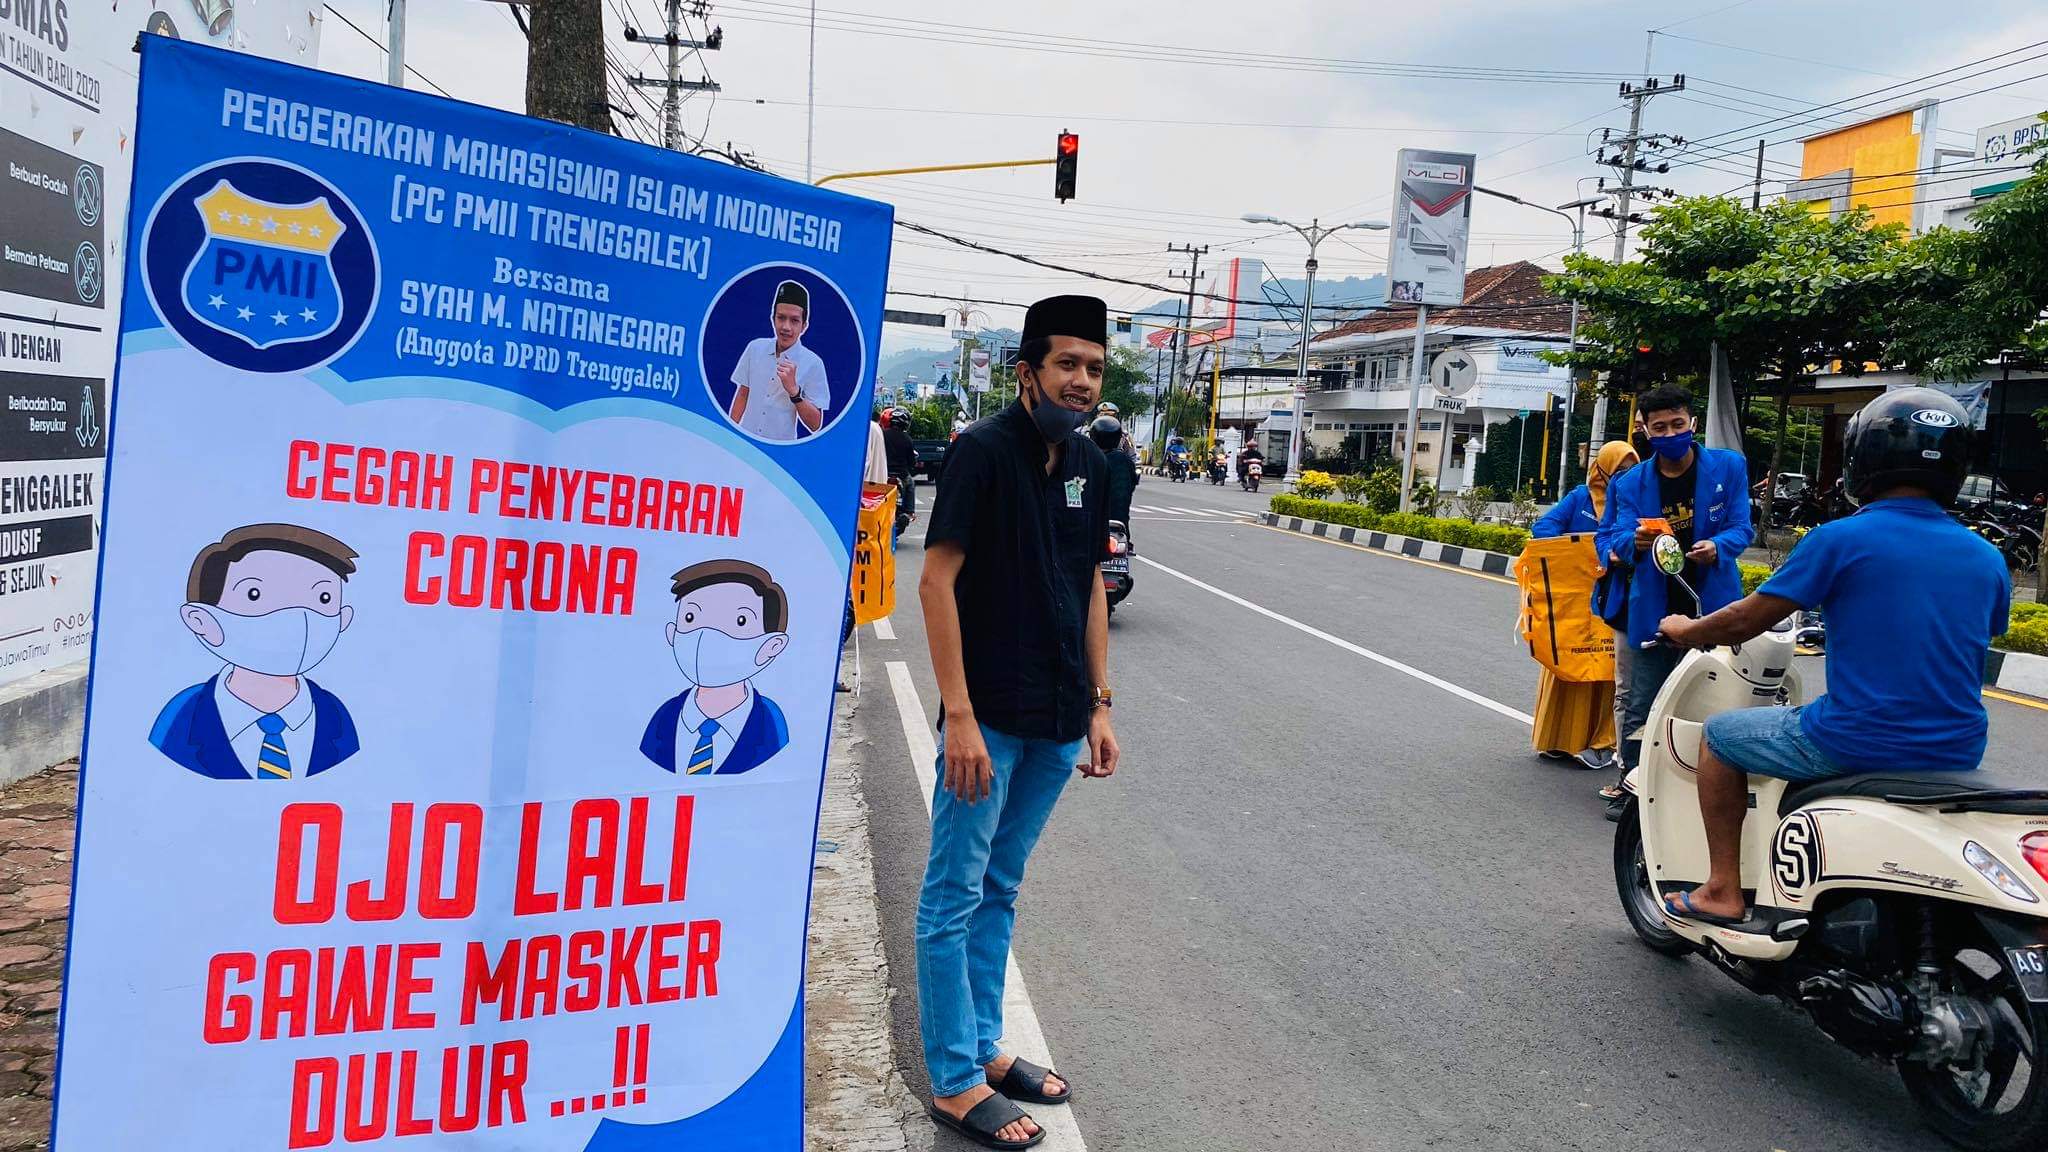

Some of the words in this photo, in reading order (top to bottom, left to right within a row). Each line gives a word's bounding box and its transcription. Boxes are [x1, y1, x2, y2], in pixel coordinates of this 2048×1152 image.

[9, 36, 44, 78] TAHUN
[47, 56, 73, 92] BARU
[76, 71, 100, 104] 2020
[10, 161, 41, 187] Berbuat
[42, 174, 69, 196] Gaduh
[222, 87, 435, 168] PERGERAKAN
[442, 134, 620, 205] MAHASISWA
[627, 174, 709, 224] ISLAM
[714, 193, 842, 253] INDONESIA
[1407, 169, 1459, 180] MLD
[453, 191, 518, 239] PMII
[5, 245, 38, 267] Bermain
[214, 247, 318, 300] PMII
[493, 257, 610, 303] Bersama
[399, 279, 474, 324] SYAH
[481, 292, 512, 330] M.
[521, 298, 687, 358] NATANEGARA
[12, 332, 61, 363] DENGAN
[395, 326, 495, 368] (Anggota
[503, 340, 560, 374] DPRD
[567, 350, 681, 398] Trenggalek)
[29, 417, 67, 435] Bersyukur
[50, 398, 67, 412] Dan
[1437, 399, 1463, 412] TRUK
[1, 472, 93, 514] ENGGALEK
[286, 439, 454, 512] CEGAH
[468, 458, 744, 538] PENYEBARAN
[0, 527, 42, 558] DUSIF
[11, 563, 46, 594] SEJUK
[403, 530, 638, 616] CORONA
[272, 802, 484, 925] OJO
[513, 794, 696, 917] LALI
[1774, 820, 1813, 891] S
[203, 941, 442, 1045] GAWE
[459, 918, 722, 1026] MASKER
[2015, 952, 2043, 973] AG
[288, 1038, 529, 1151] DULUR
